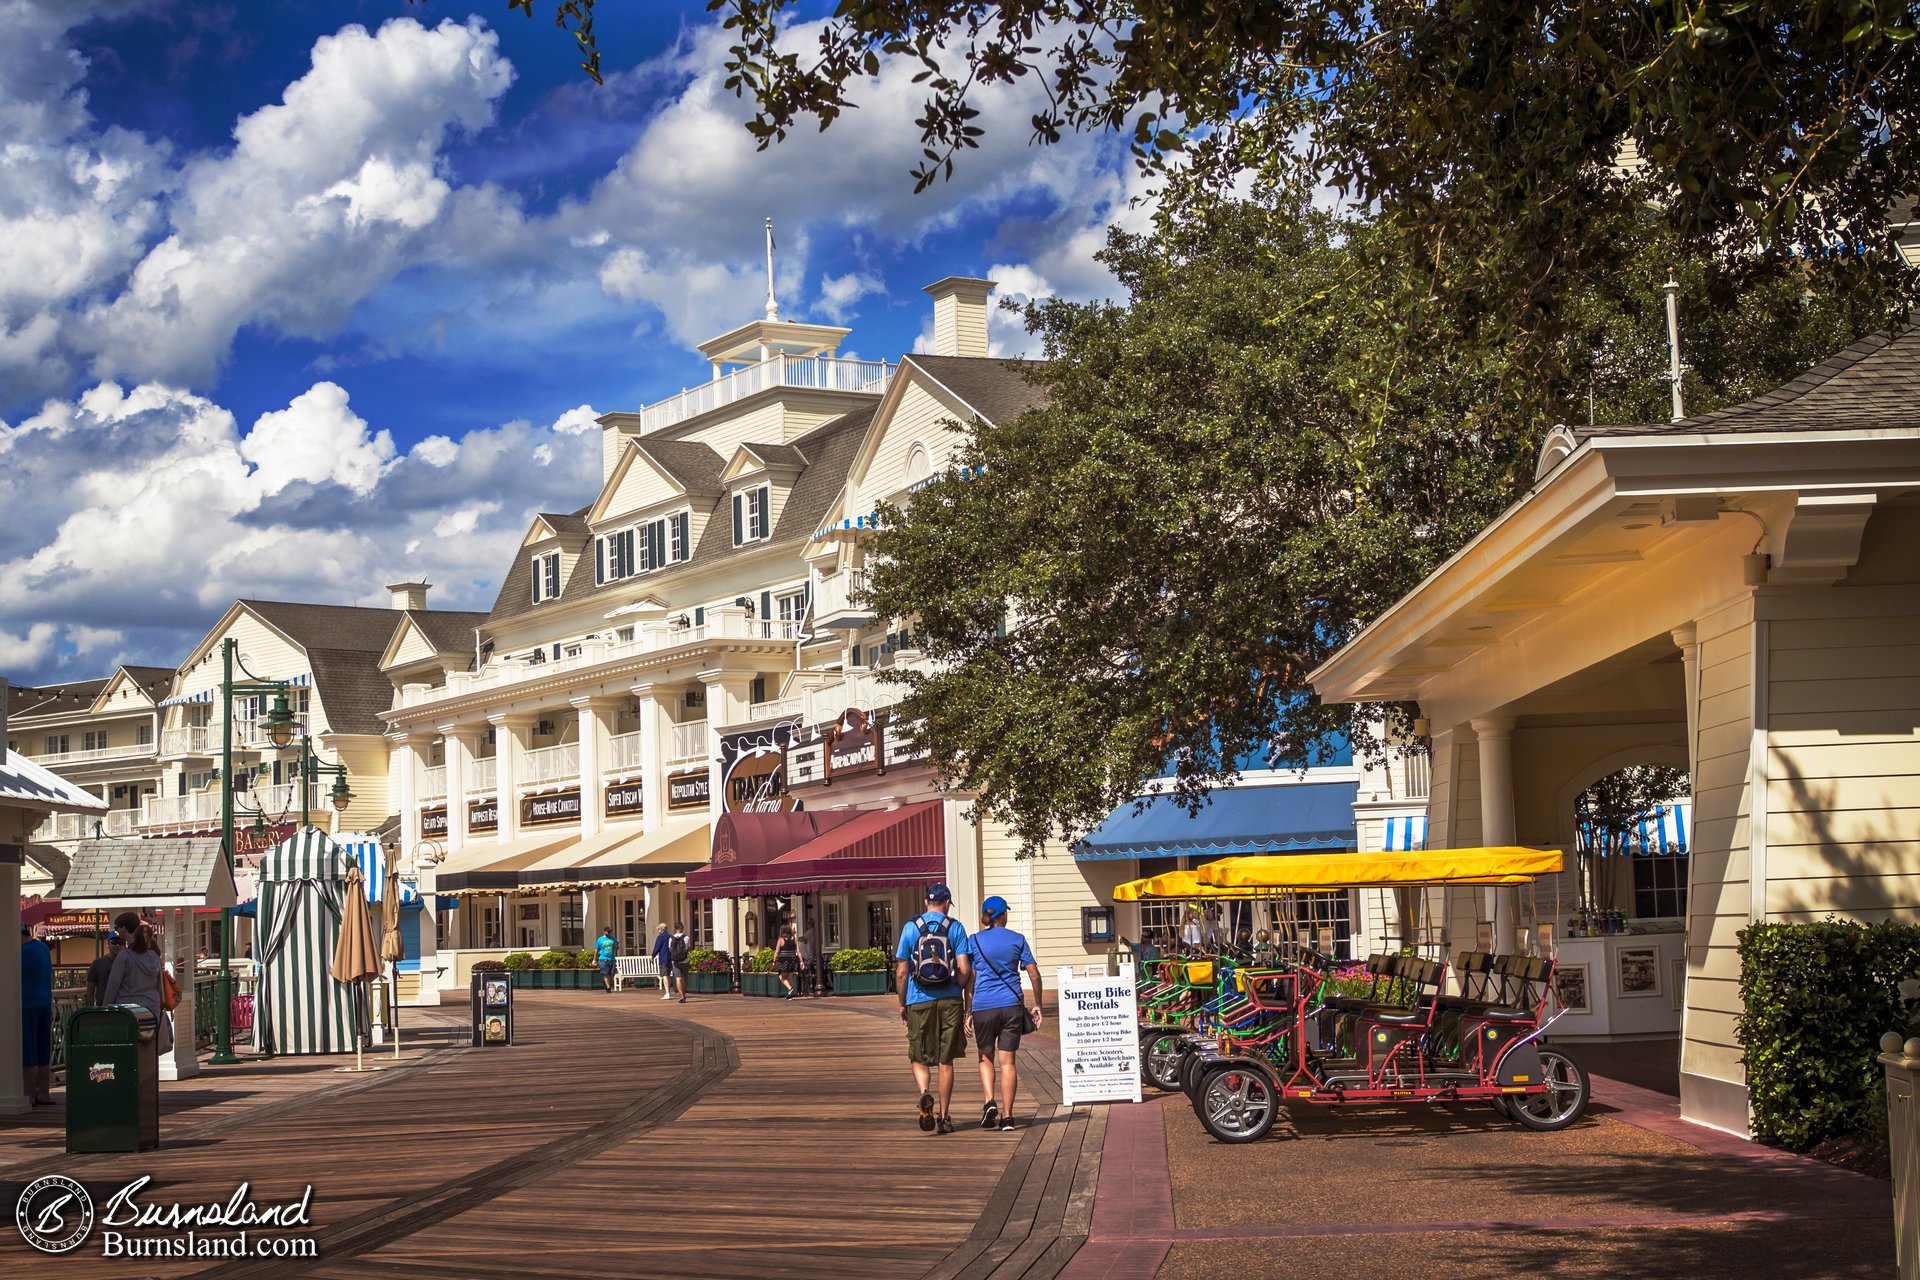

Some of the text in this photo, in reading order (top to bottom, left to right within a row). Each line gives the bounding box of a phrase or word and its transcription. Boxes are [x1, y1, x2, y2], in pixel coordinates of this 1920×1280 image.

[730, 772, 782, 803] TRATTO
[608, 792, 621, 807] SUPER
[235, 831, 284, 853] BAKERY
[1064, 987, 1132, 1000] Surrey Bike
[1077, 999, 1119, 1011] Rentals
